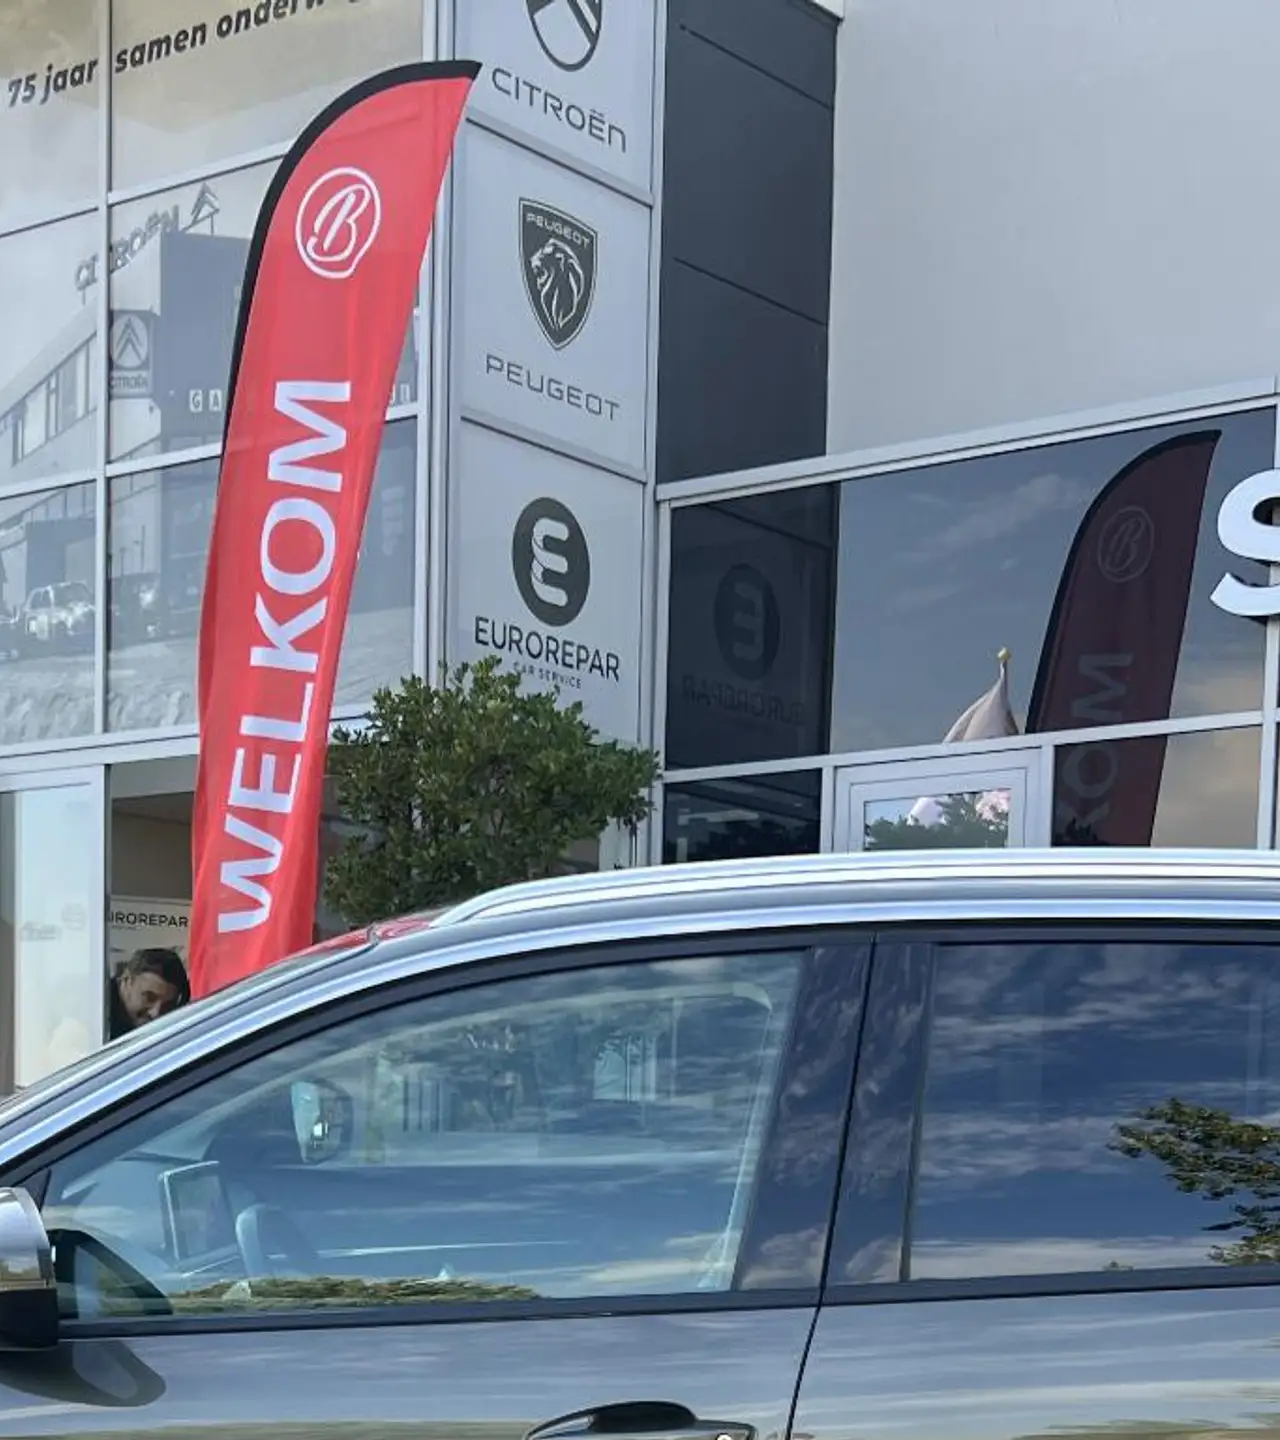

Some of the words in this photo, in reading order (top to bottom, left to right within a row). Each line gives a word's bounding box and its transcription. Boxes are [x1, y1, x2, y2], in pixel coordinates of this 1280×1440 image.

[8, 73, 37, 108] 75
[39, 58, 100, 106] jaar
[114, 21, 207, 73] samen
[525, 212, 592, 248] PEUGEOT
[485, 353, 620, 421] PEUGEOT
[217, 380, 352, 934] WELKOM
[474, 616, 620, 683] EUROREPAR
[539, 668, 583, 689] SERVICE
[109, 911, 189, 928] ROREPAR
